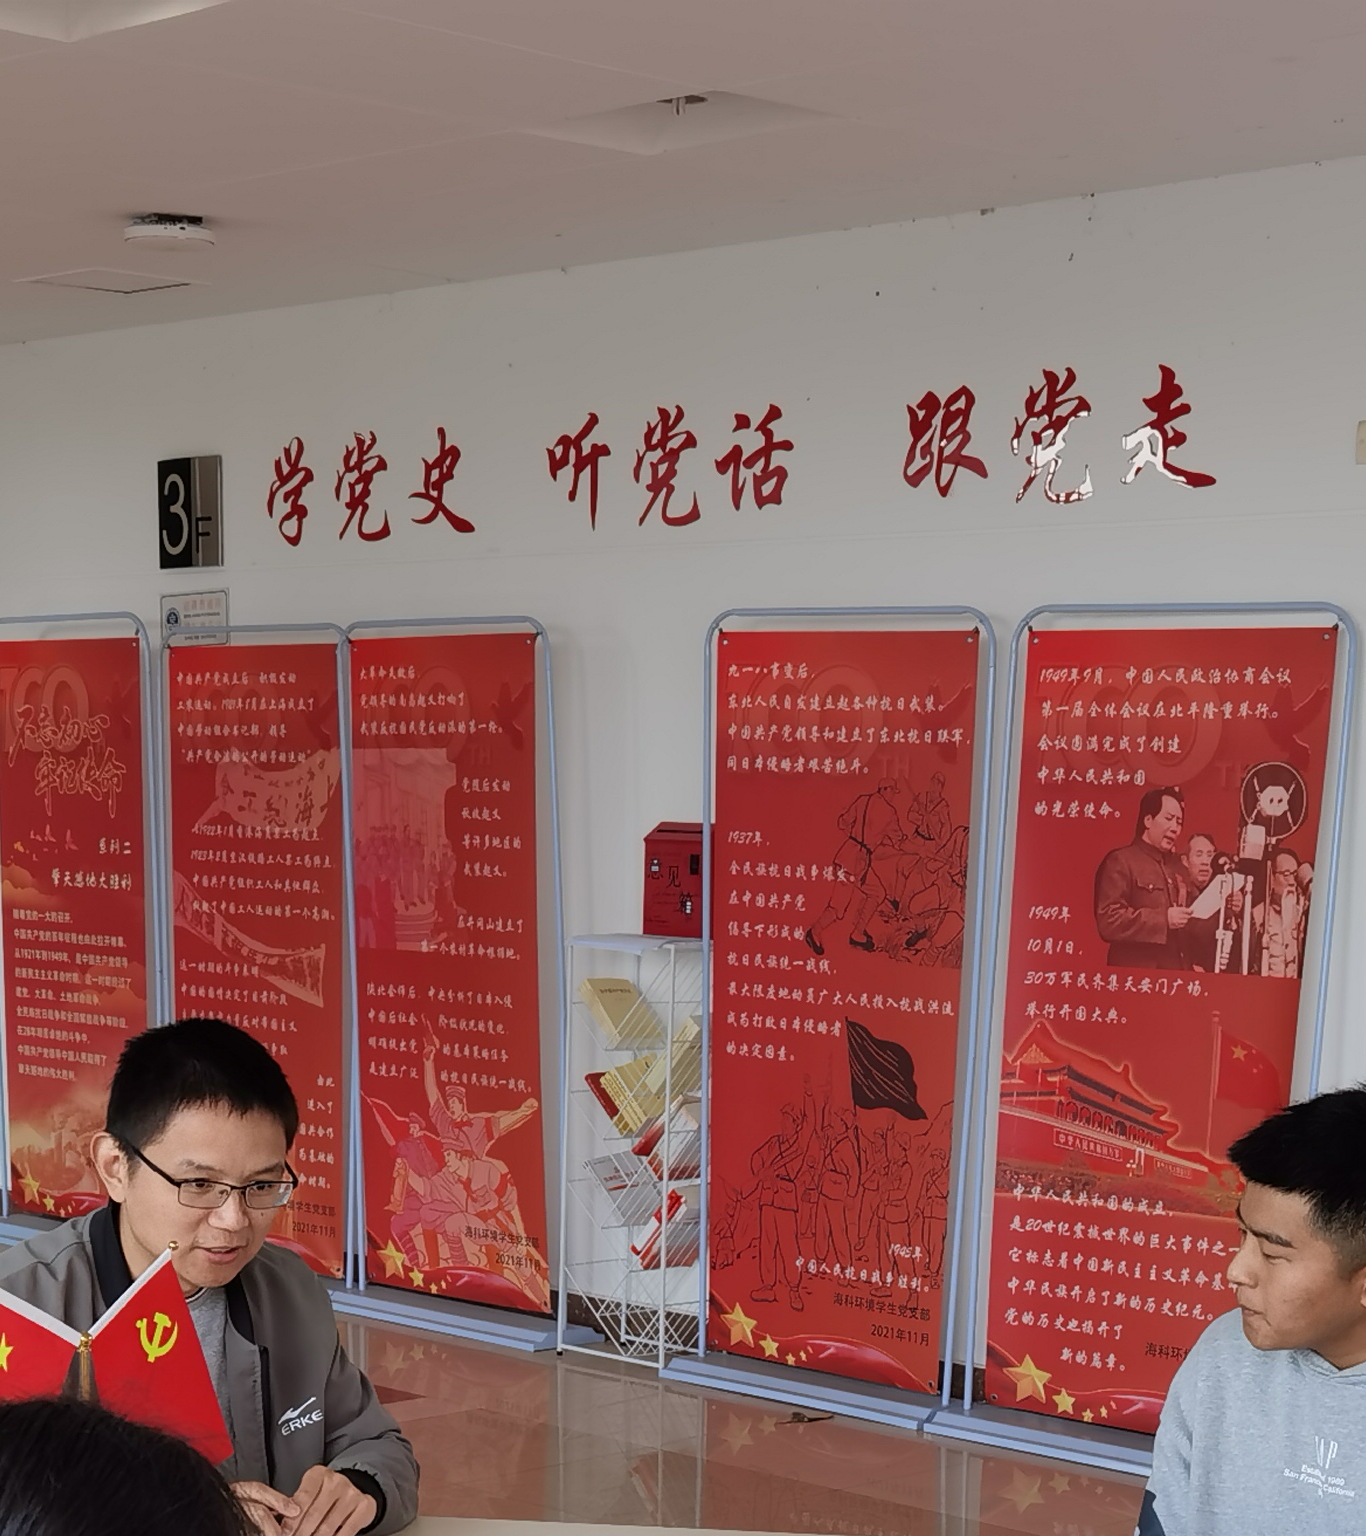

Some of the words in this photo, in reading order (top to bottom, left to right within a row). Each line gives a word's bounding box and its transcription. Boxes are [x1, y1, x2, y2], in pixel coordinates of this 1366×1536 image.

[267, 427, 476, 547] 学党史
[546, 403, 795, 531] 听党话
[902, 363, 1217, 505] 跟党走
[727, 661, 816, 680] 九一八事变后，
[1039, 666, 1292, 686] 1949年9月，中国人民政治协商会议
[727, 693, 946, 715] 东北人民自发建立起各种抗日武装。
[1040, 700, 1280, 720] 第一届全体会议在北平隆重举行。
[727, 725, 972, 748] 中国共产党领导和建立了东北抗日联军，
[1036, 734, 1183, 754] 会议圆满完成了创建
[1036, 766, 1146, 786] 中华人民共和国
[1034, 801, 1122, 819] 的光荣使命。
[728, 862, 856, 884] 全民族抗日战争爆发。
[728, 891, 807, 912] 在中国共产党
[1028, 904, 1072, 924] 1949年
[1023, 969, 1209, 998] 30万军民齐集天安门广场，
[725, 1010, 842, 1038] 成为打败日本侵略者
[1024, 1000, 1128, 1025] 举行开国大典。
[725, 1040, 796, 1062] 的决定因素。
[1011, 1184, 1175, 1219] 中华人民共和国的成立，
[795, 1257, 930, 1293] 中国人民抗日战争胜利。
[833, 1291, 931, 1321] 海科环境学生党支部
[1007, 1277, 1214, 1322] 中华民族开启了新的历史纪元。
[1004, 1306, 1123, 1339] 党的历史也揭开了
[870, 1324, 930, 1347] 2021年11月
[1060, 1345, 1127, 1373] 新的篇章。
[281, 1409, 325, 1436] ERKE
